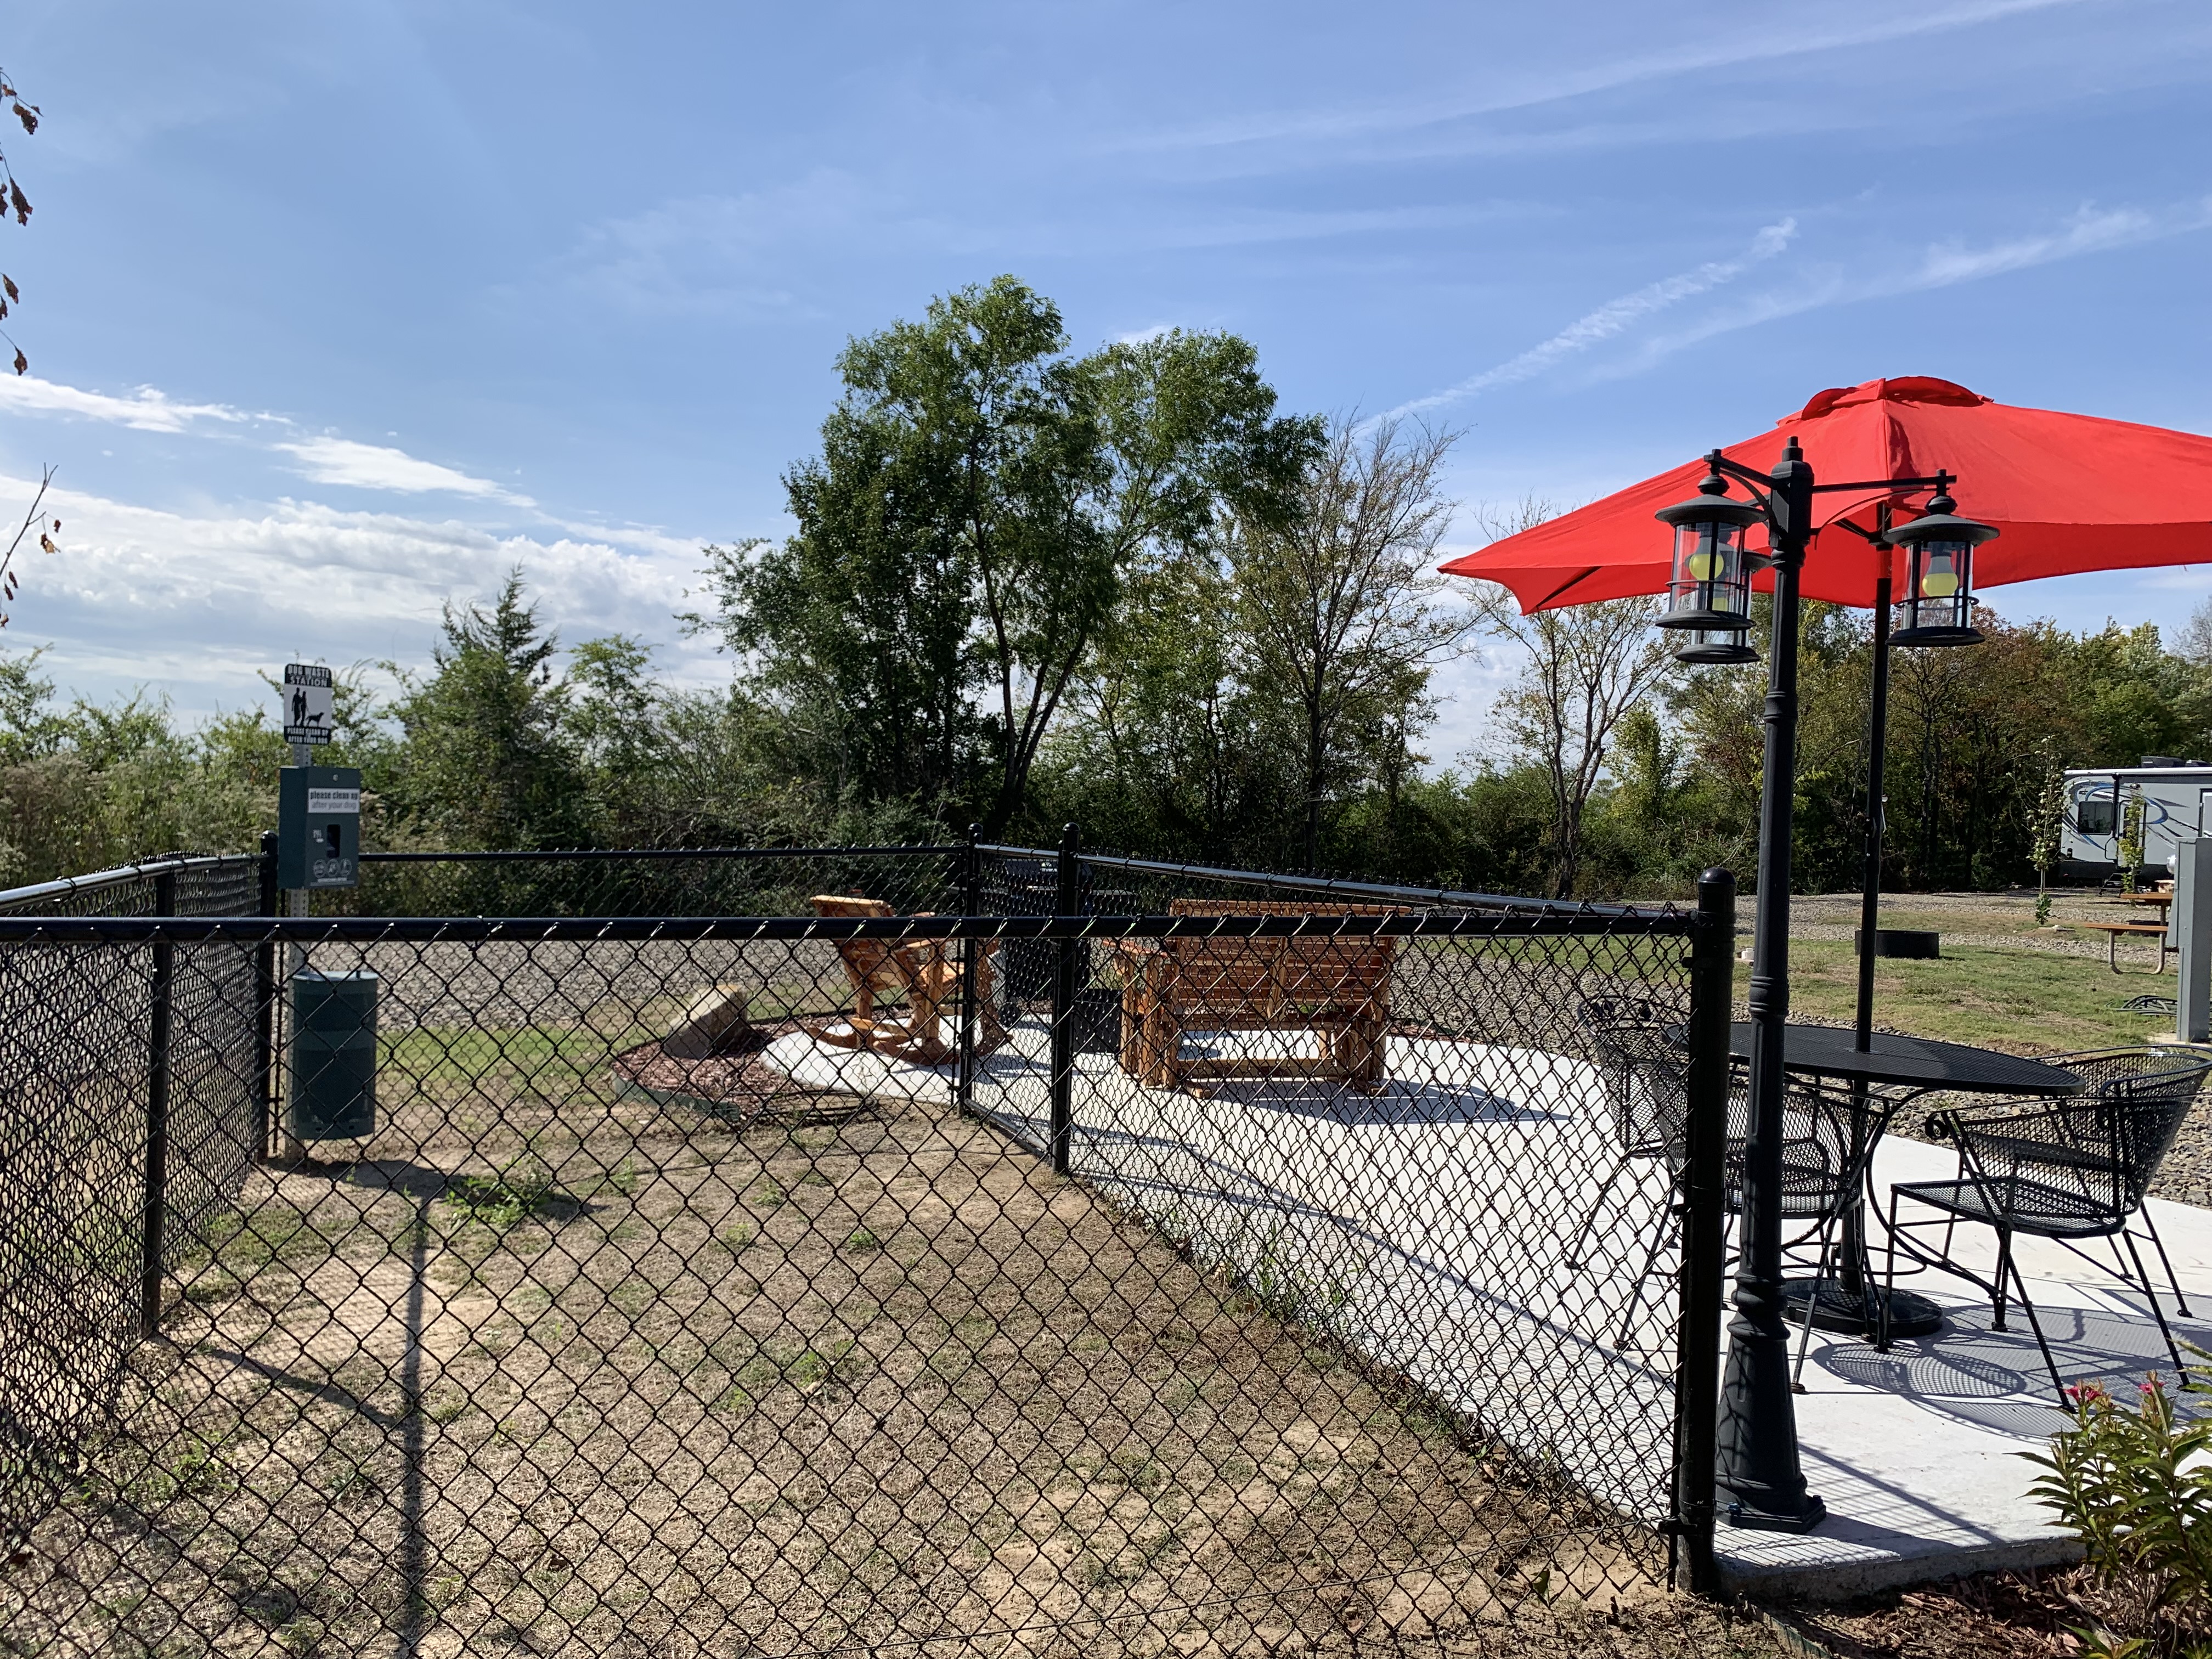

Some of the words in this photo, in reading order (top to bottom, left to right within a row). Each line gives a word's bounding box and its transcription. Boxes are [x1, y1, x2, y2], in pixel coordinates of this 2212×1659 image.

[288, 665, 303, 675] DOG
[305, 667, 329, 678] WASTE
[290, 675, 328, 687] STATION
[287, 727, 304, 735] PLEASE
[311, 791, 331, 799] please
